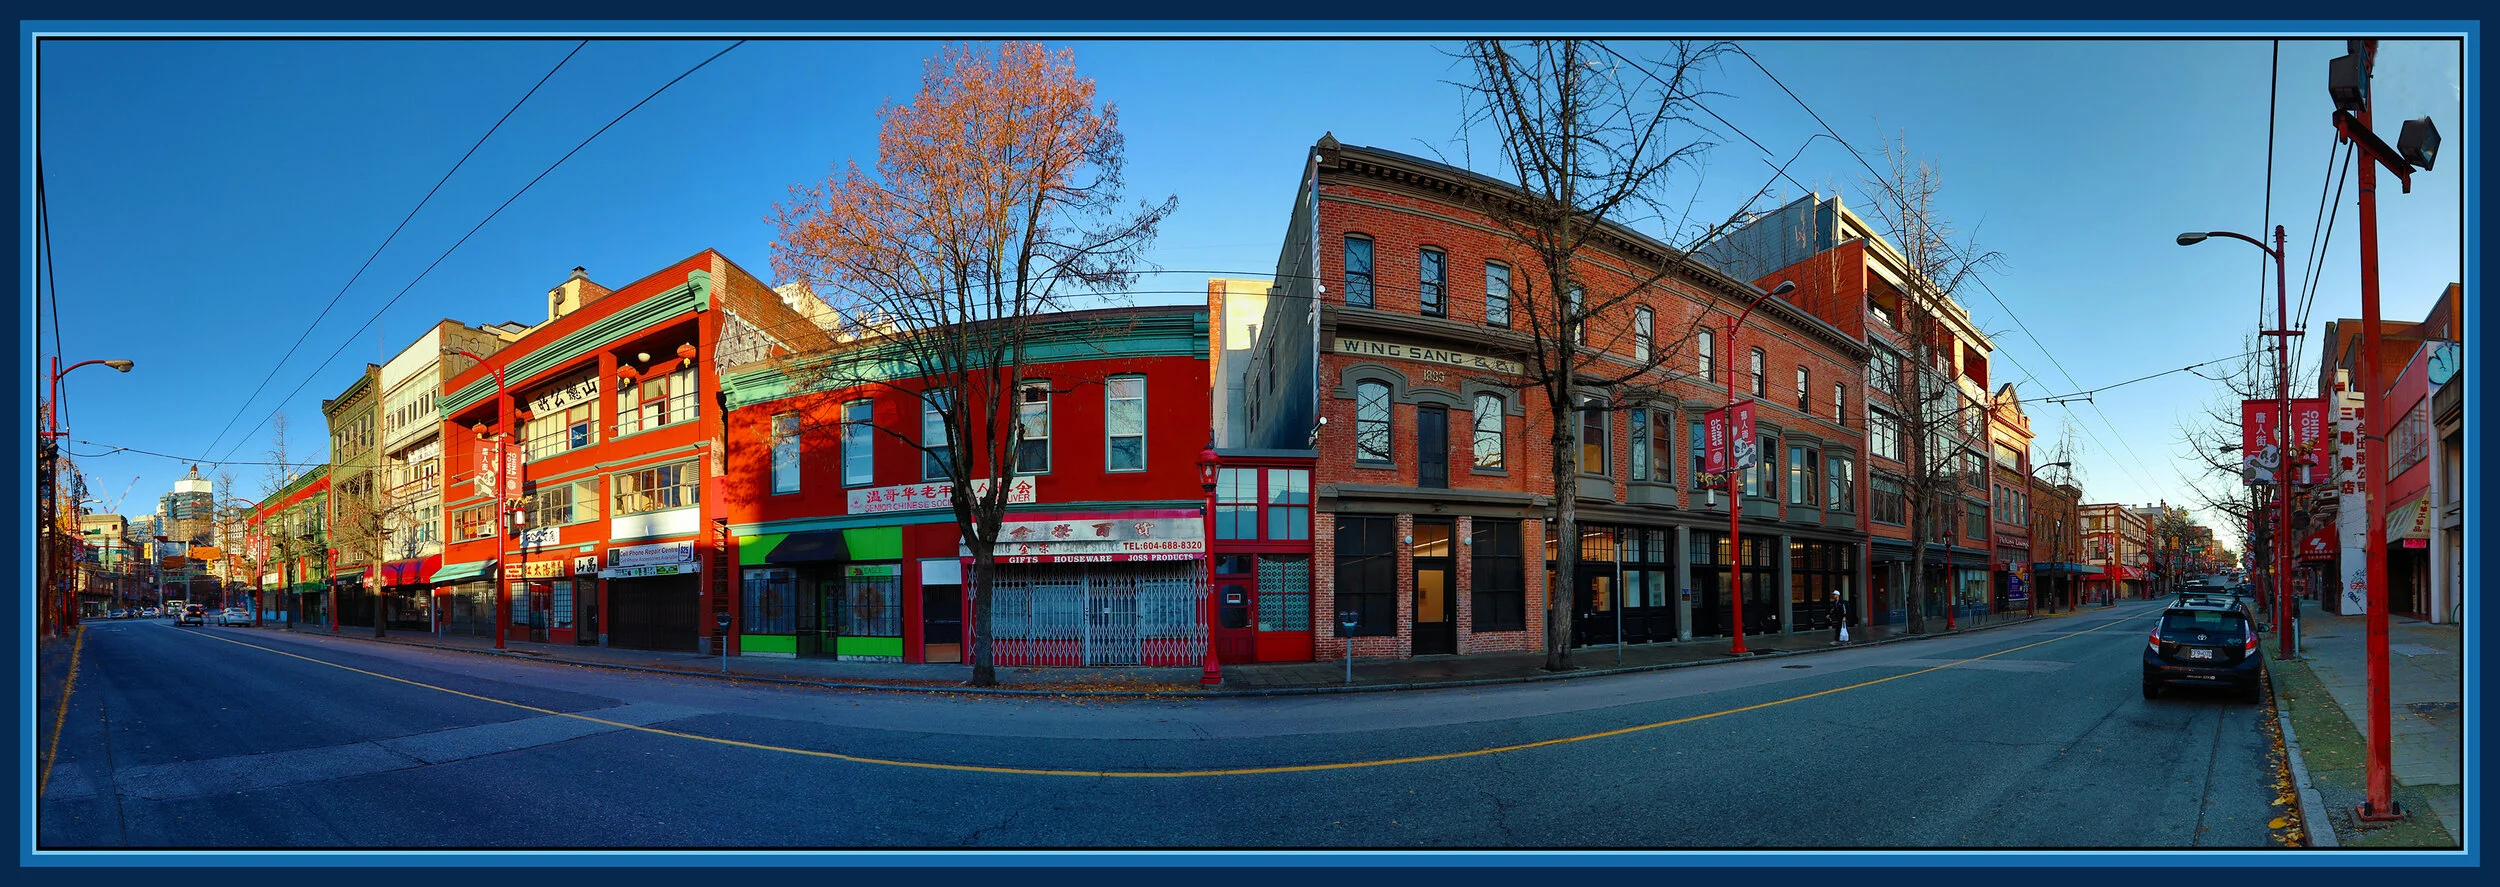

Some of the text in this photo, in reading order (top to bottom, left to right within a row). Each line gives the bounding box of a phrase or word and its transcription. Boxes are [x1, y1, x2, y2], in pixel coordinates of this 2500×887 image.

[1343, 340, 1400, 356] WING
[1409, 347, 1462, 363] SANG
[1423, 369, 1445, 383] 1889
[2255, 412, 2267, 447] 唐人街
[2310, 410, 2319, 443] CHIN
[865, 503, 893, 513] SENIOR
[893, 501, 928, 511] CHINESE
[644, 547, 660, 556] Repair
[661, 546, 678, 554] Centre
[1123, 541, 1203, 551] TEL:604-688-8320
[1008, 555, 1113, 564] GIFTS HOUSEWARE
[1127, 553, 1194, 562] JOSS PRODUCTS
